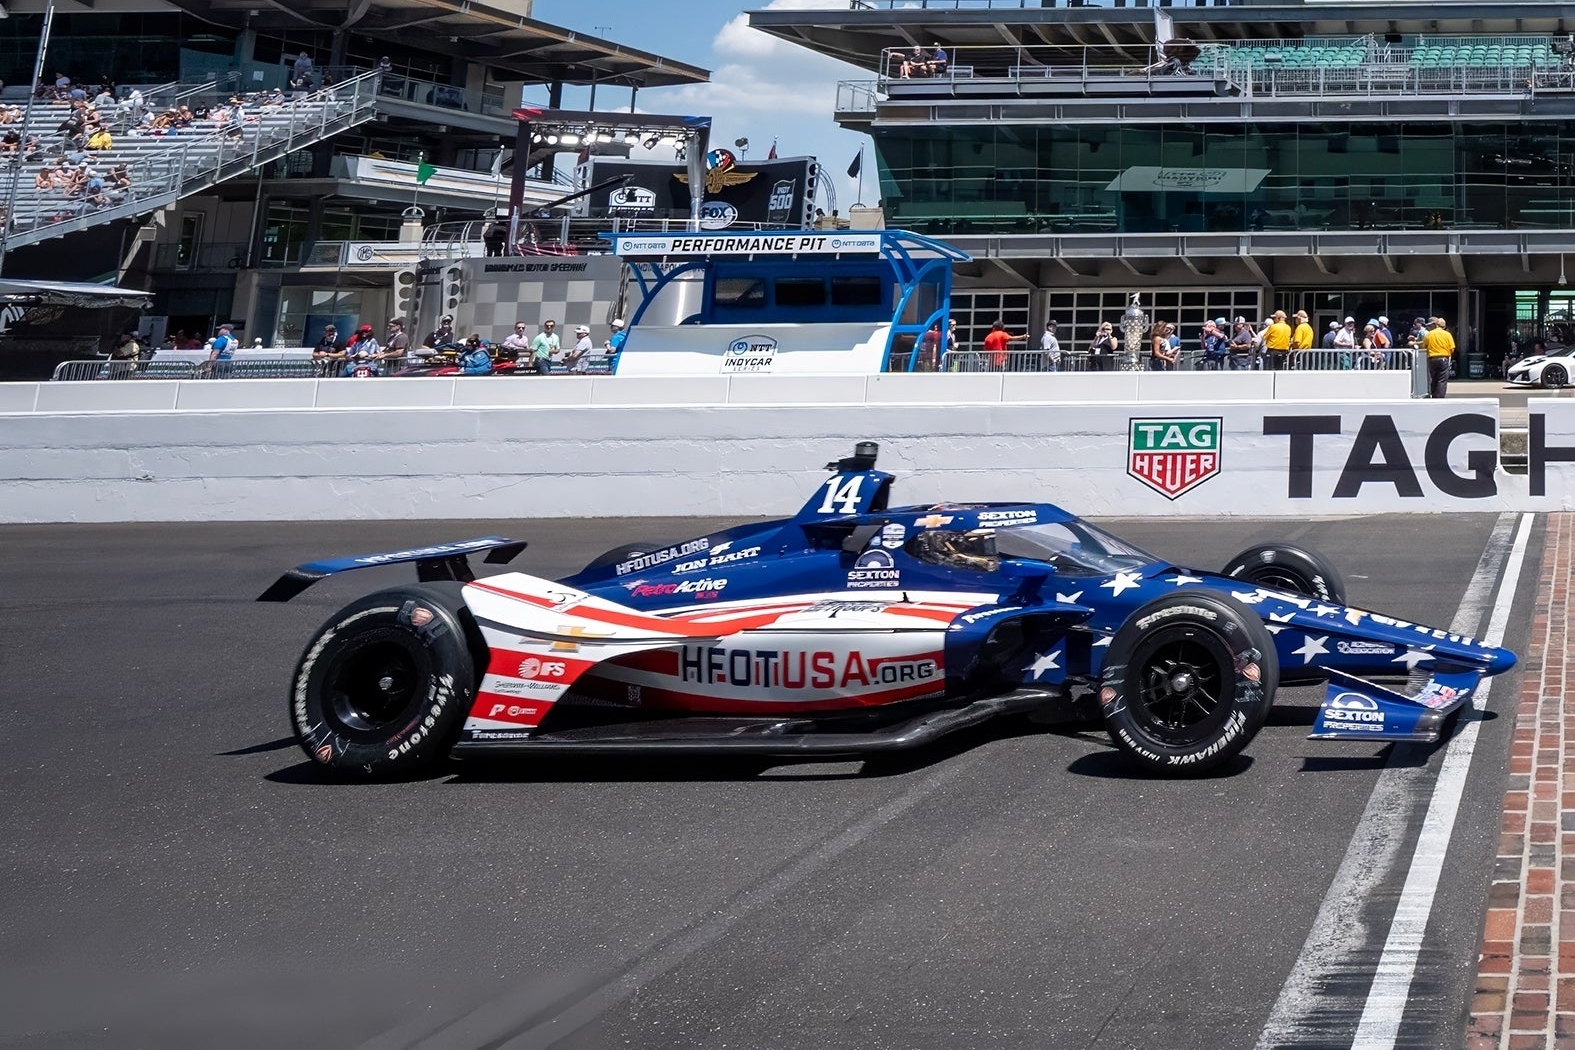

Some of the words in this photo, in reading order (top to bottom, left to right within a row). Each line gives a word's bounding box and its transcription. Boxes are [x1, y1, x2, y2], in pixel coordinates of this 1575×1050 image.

[770, 194, 793, 210] 500
[701, 206, 728, 219] FOX
[671, 237, 796, 251] PERFORMANCE
[799, 237, 827, 250] PIT
[550, 262, 588, 272] SPEEDWAY
[749, 344, 773, 352] NTT
[725, 358, 773, 366] INDYCAR
[1140, 424, 1215, 449] TAG
[1134, 453, 1217, 493] HEUER
[817, 475, 865, 514] 14
[977, 510, 1037, 521] SEXTON
[616, 537, 710, 576] HFOTUSA.ORG
[671, 558, 709, 574] JON
[847, 570, 900, 580] SEXTON
[1324, 708, 1385, 722] SEXTON
